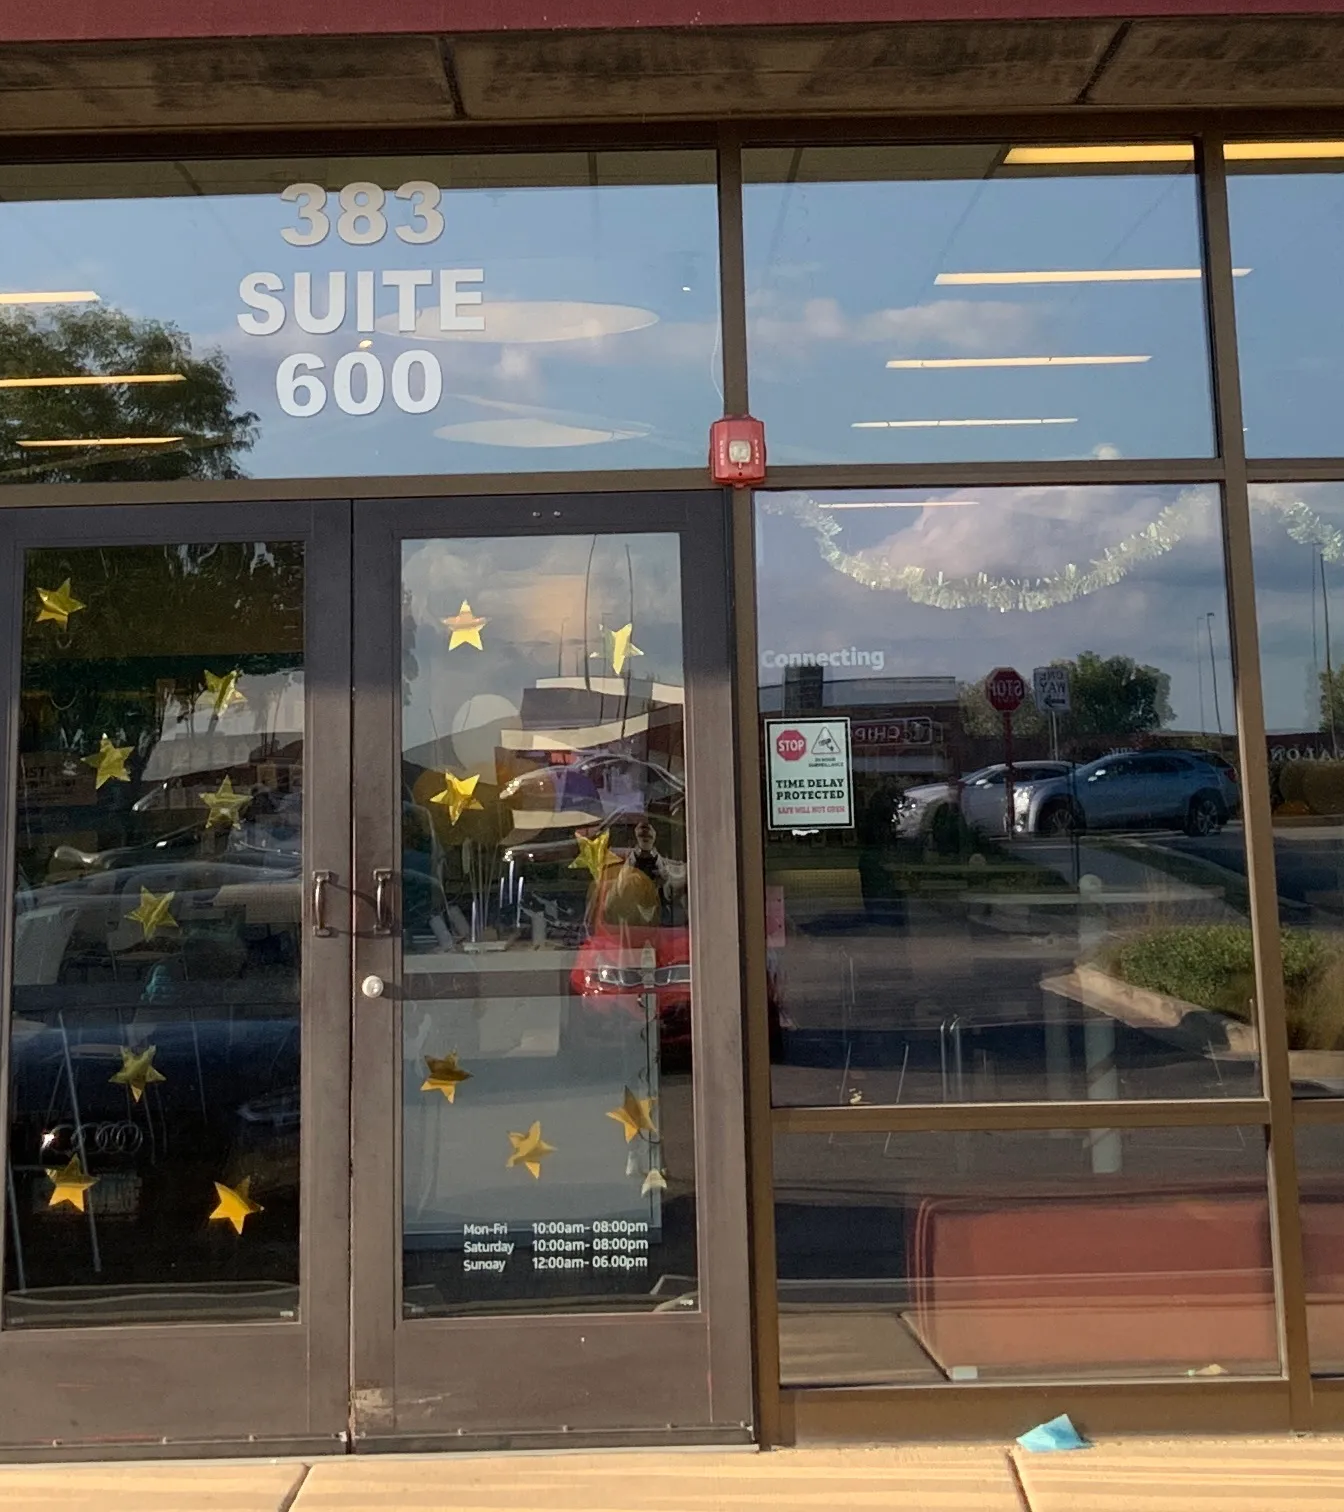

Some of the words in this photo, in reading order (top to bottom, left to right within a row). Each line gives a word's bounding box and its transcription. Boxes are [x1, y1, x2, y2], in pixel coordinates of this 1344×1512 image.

[280, 181, 445, 246] 383
[237, 268, 485, 335] SUITE
[276, 350, 442, 417] 600
[761, 646, 885, 671] Connecting
[778, 739, 805, 752] STOP
[776, 779, 804, 788] TIME
[808, 778, 844, 788] DELAY
[776, 790, 845, 800] PROTECTED
[463, 1223, 508, 1235] Mon-Fri
[592, 1221, 648, 1235] 08:00pm
[463, 1240, 514, 1255] Saturday
[592, 1238, 648, 1252] 08:00pm
